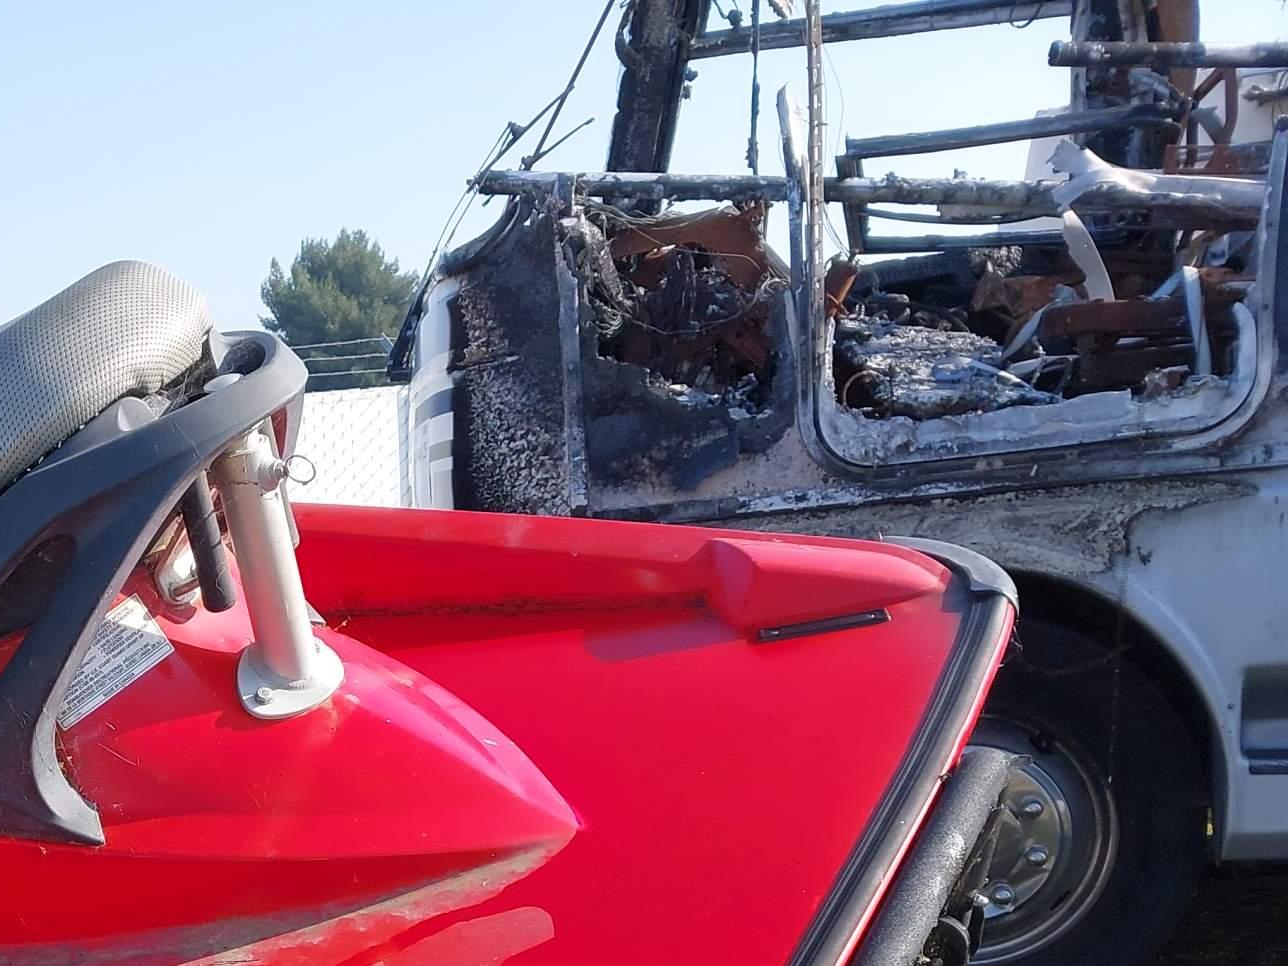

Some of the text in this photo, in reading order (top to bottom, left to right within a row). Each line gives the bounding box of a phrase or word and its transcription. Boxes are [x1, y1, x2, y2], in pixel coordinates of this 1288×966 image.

[93, 662, 123, 686] RECREATIONAL
[122, 646, 144, 664] PRODUCTS
[97, 657, 112, 670] COAST
[111, 647, 126, 660] GUARD
[102, 687, 115, 697] MADE
[118, 672, 135, 686] CANADA
